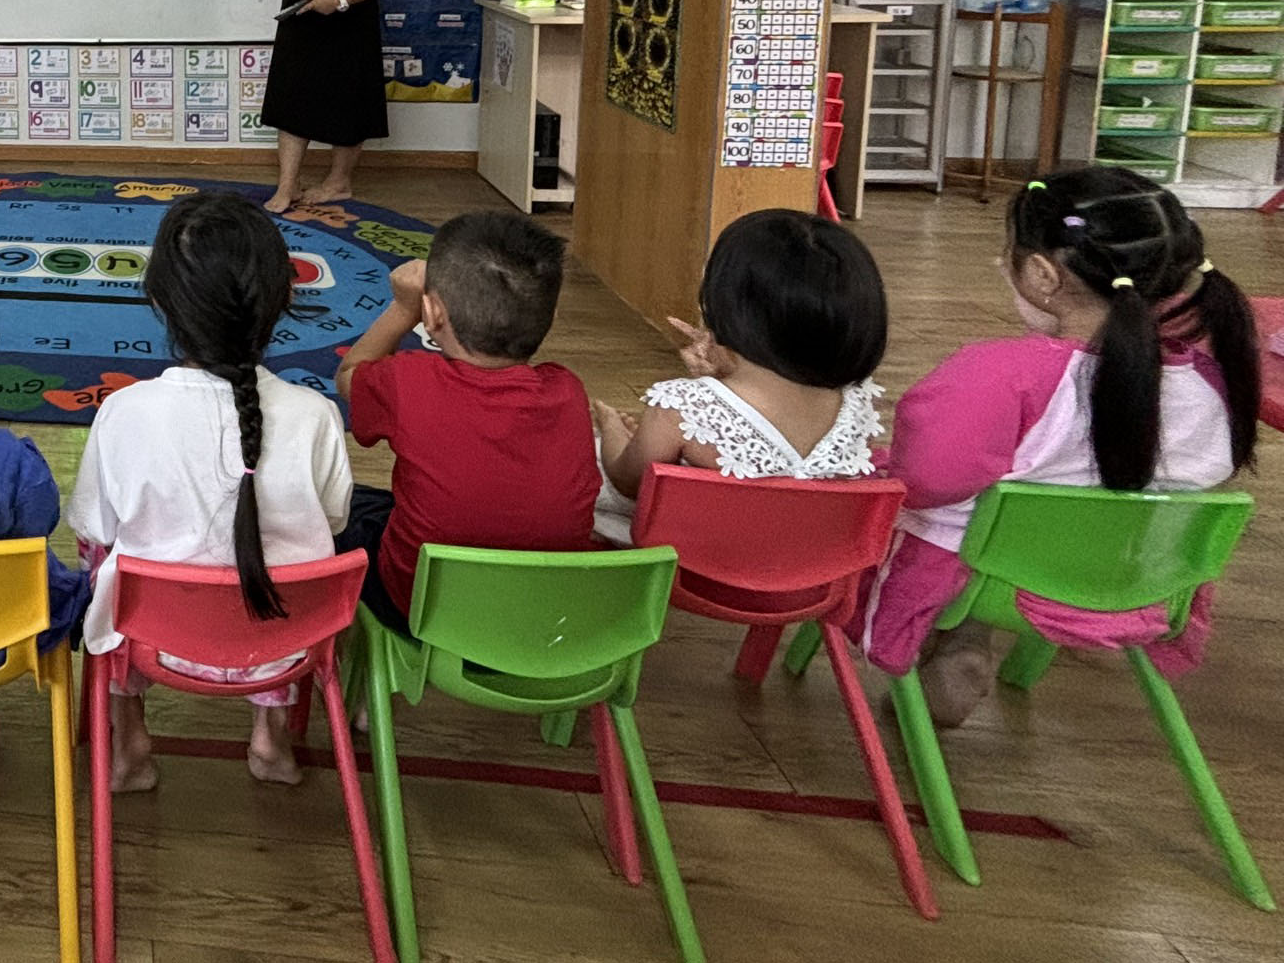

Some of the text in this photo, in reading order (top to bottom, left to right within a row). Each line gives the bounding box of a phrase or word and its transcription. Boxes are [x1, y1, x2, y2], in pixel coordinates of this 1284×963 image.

[737, 19, 756, 31] 50
[735, 44, 754, 55] 60
[30, 49, 42, 66] 2
[81, 50, 92, 65] 3
[132, 50, 145, 66] 4
[188, 50, 200, 66] 5
[242, 49, 255, 68] 6
[734, 68, 753, 80] 70
[30, 80, 43, 98] 9
[80, 80, 96, 97] 10
[133, 81, 143, 98] 11
[187, 81, 201, 97] 12
[241, 82, 255, 98] 13
[733, 93, 751, 104] 80
[30, 111, 43, 127] 16
[80, 112, 93, 128] 17
[132, 113, 146, 128] 18
[186, 113, 201, 128] 19
[241, 113, 263, 129] 20
[731, 122, 749, 133] 90
[727, 146, 750, 157] 100
[48, 181, 106, 189] Verde
[118, 183, 197, 194] Amarillo
[8, 201, 34, 210] Rr
[55, 203, 82, 212] Ss
[111, 206, 136, 214] Tt
[371, 223, 429, 254] Verde
[49, 251, 81, 269] 5
[106, 254, 139, 271] 4
[42, 277, 79, 288] five
[317, 315, 354, 333] Aa
[33, 337, 71, 350] Ee
[113, 340, 153, 354] Dd
